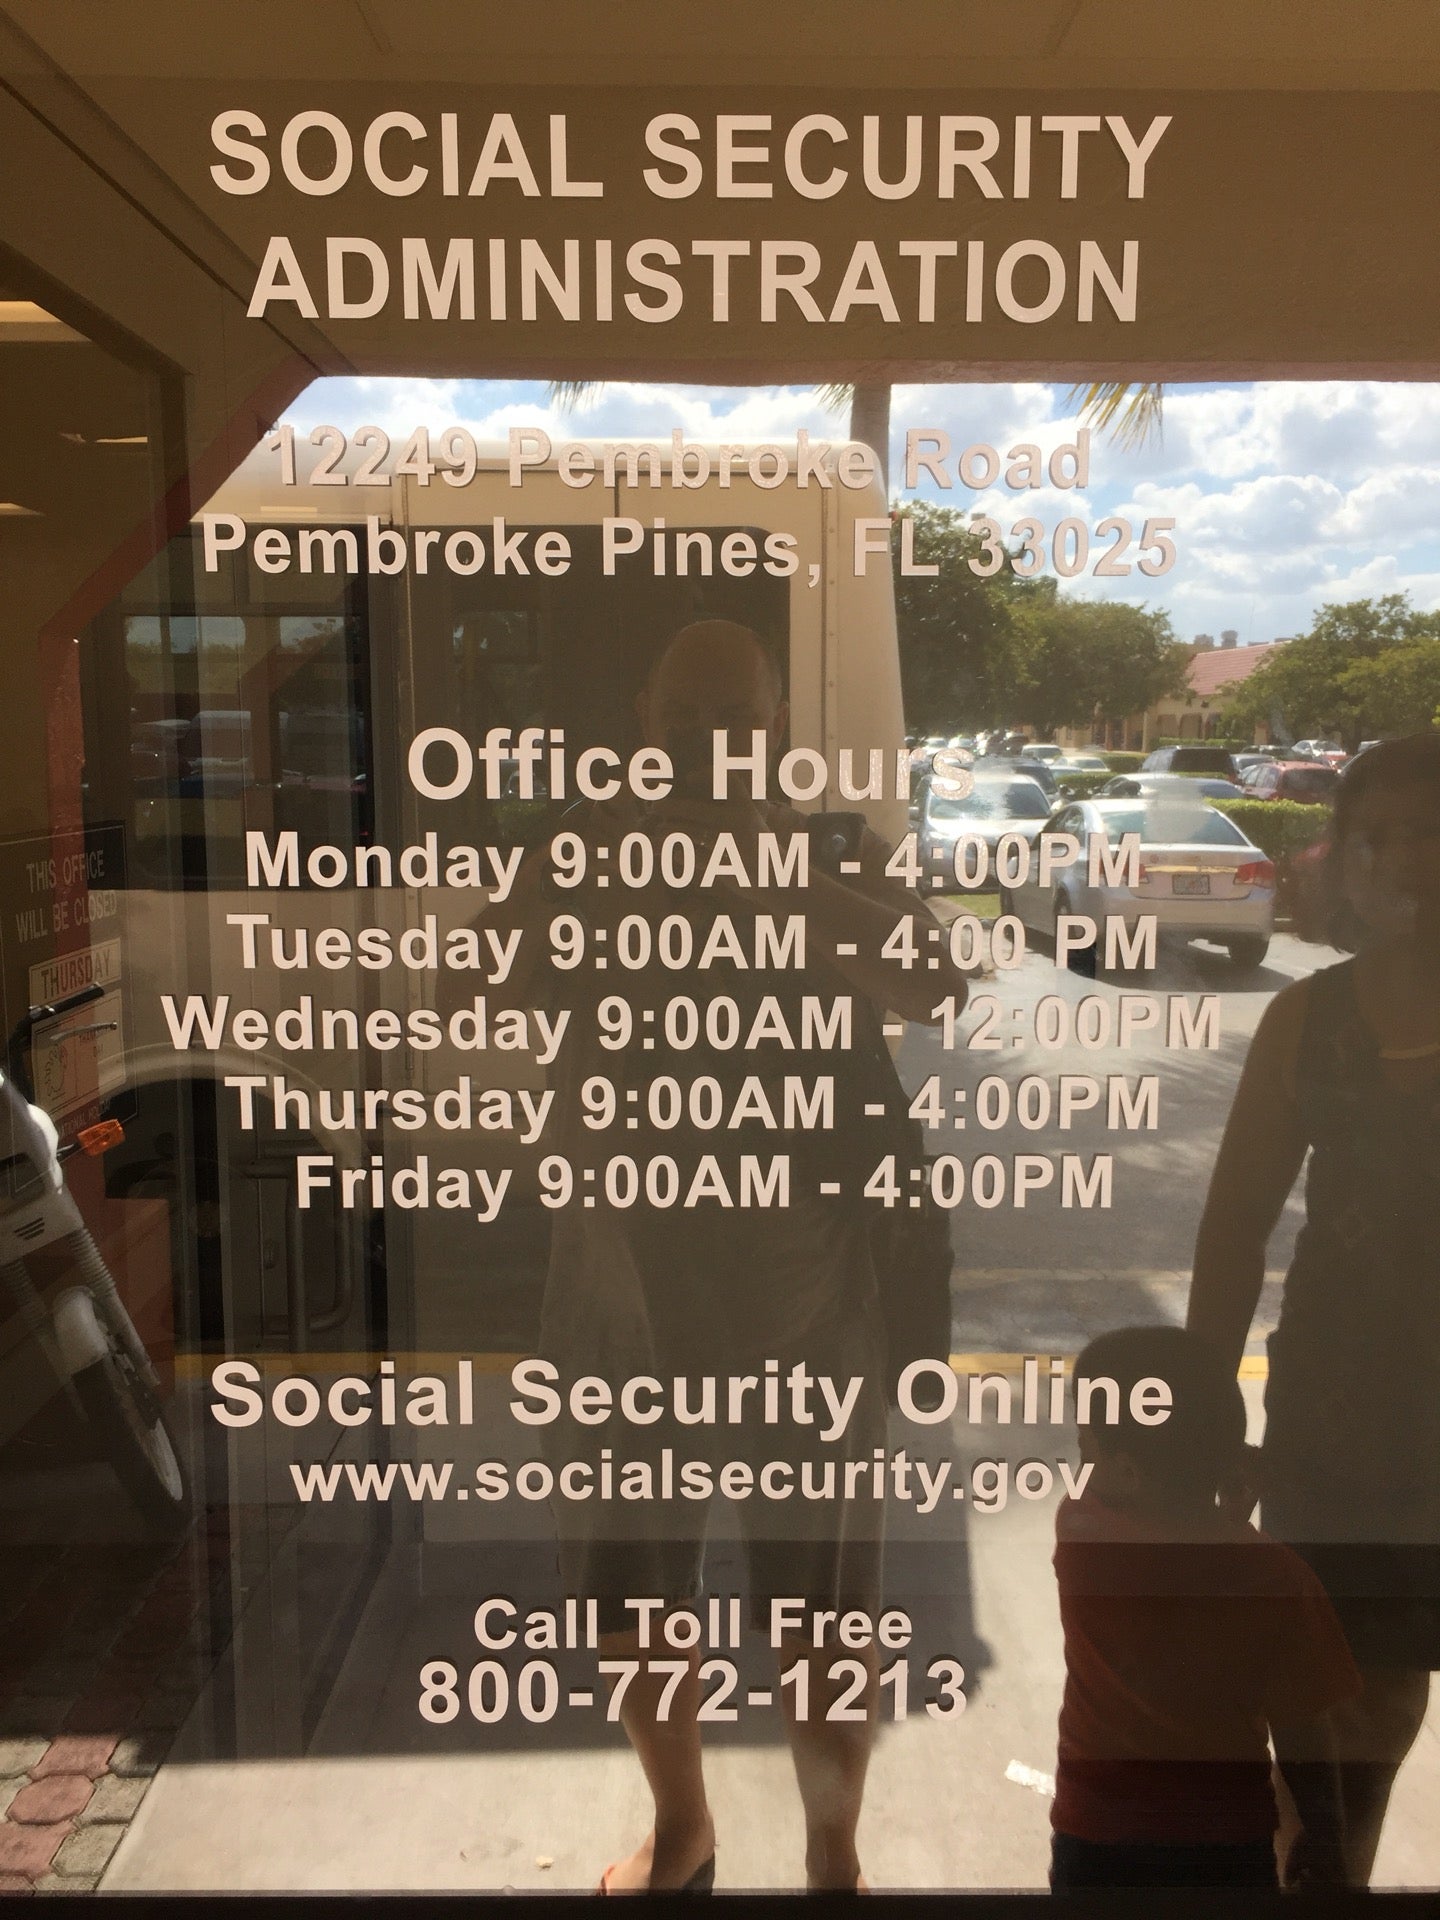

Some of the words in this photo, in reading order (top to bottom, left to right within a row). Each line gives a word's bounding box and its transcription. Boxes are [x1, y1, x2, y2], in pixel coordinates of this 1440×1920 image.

[210, 109, 604, 198] SOCIAL
[643, 113, 1173, 200] SECURITY
[246, 235, 1140, 323] ADMINISTRATION
[269, 424, 478, 488] 12249
[508, 427, 876, 490] Pembroke
[904, 427, 1092, 490] Road
[202, 513, 573, 576] Pembroke
[602, 516, 821, 588] Pines,
[853, 516, 940, 577] FL
[967, 516, 1178, 578] 33025
[408, 727, 675, 800] Office
[711, 728, 976, 801] Hours
[26, 858, 57, 893] THIS
[62, 850, 105, 886] OFFICE
[245, 831, 525, 903] Monday
[550, 832, 810, 889] 9:00AM
[884, 832, 1142, 889] 4:00PM
[15, 908, 48, 944] WILL
[52, 900, 70, 933] BE
[74, 890, 118, 927] CLOSED
[226, 914, 523, 985] Tuesday
[549, 914, 807, 970] 9:00AM
[880, 914, 1026, 971] 4:00
[1055, 914, 1158, 970] PM
[40, 949, 113, 1002] THURSDAY
[160, 995, 572, 1065] Wednesday
[596, 995, 853, 1051] 9:00AM
[930, 995, 1221, 1051] 12:00PM
[224, 1076, 556, 1144] Thursday
[580, 1076, 835, 1130] 9:00AM
[908, 1076, 1159, 1130] 4:00PM
[297, 1155, 513, 1223] Friday
[537, 1155, 791, 1209] 9:00AM
[863, 1155, 1113, 1209] 4:00PM
[210, 1360, 474, 1427] Social
[509, 1359, 864, 1442] Security
[896, 1358, 1174, 1426] Online
[289, 1448, 1096, 1514] www.socialsecurity.gov
[473, 1598, 598, 1650] Call
[624, 1598, 742, 1649] Toll
[769, 1598, 913, 1649] Free
[418, 1659, 968, 1724] 800-772-1213
